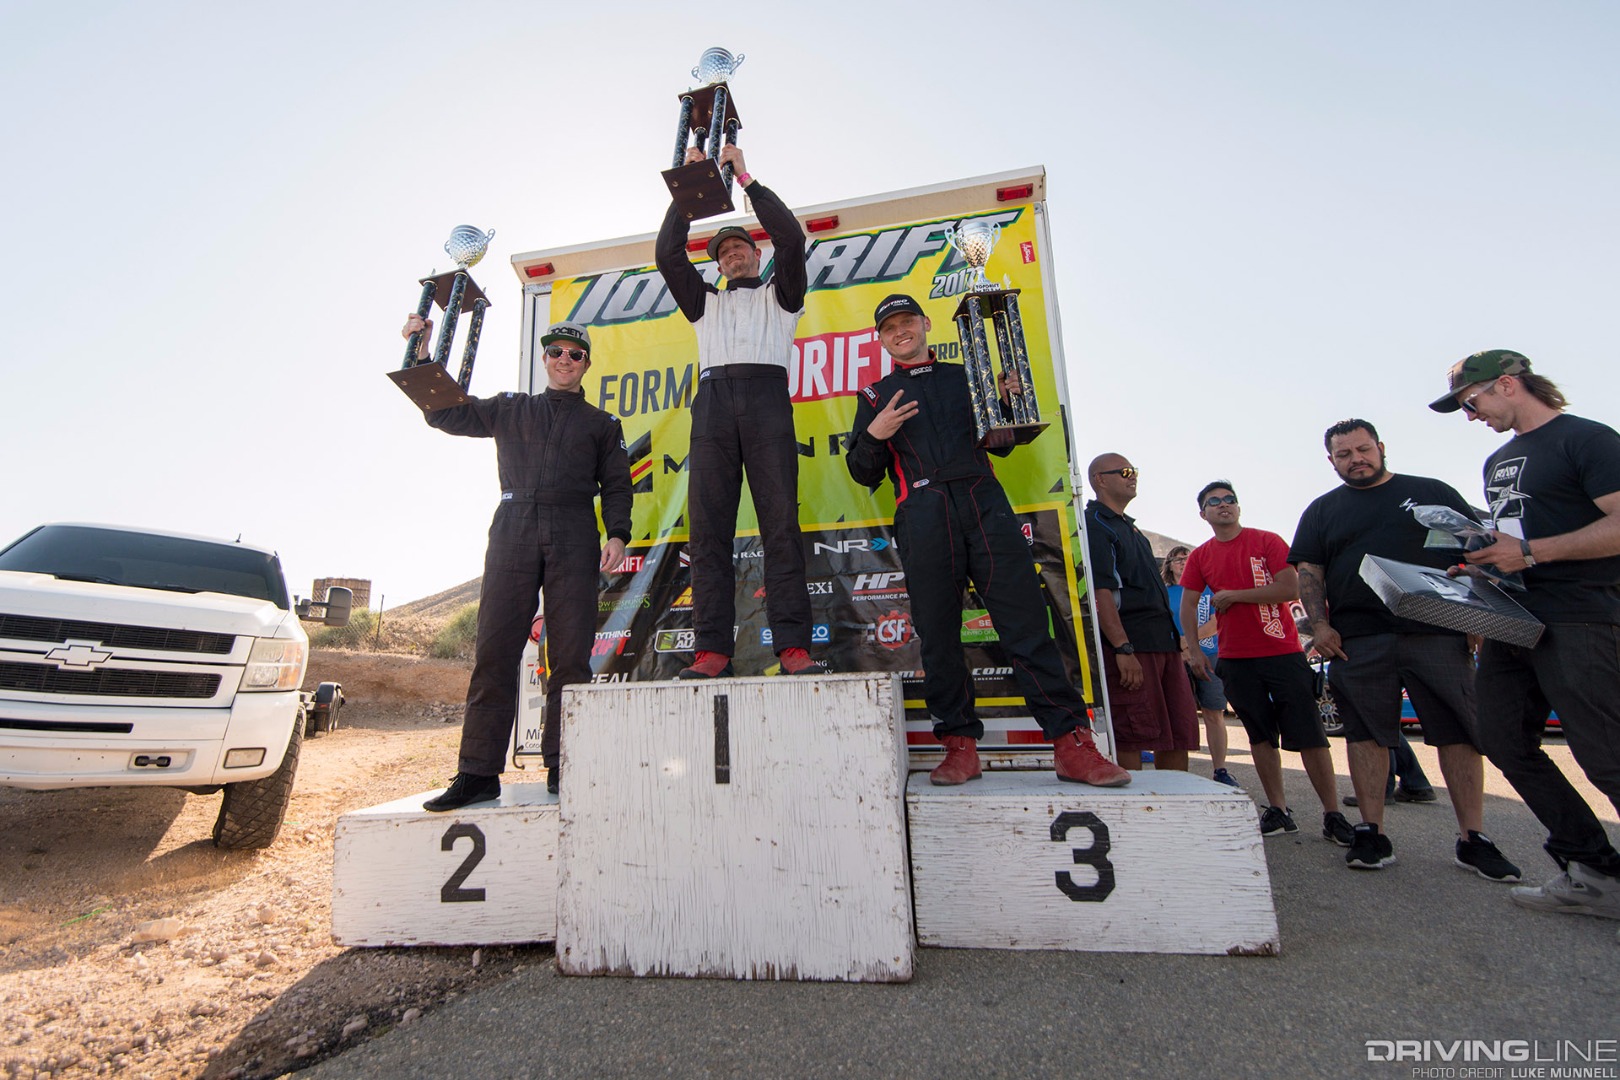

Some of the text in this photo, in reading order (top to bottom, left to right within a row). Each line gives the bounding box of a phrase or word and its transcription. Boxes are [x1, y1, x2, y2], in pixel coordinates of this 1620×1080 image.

[928, 268, 977, 299] 2017
[599, 362, 699, 417] FORM
[609, 556, 642, 573] RIFT
[676, 632, 695, 640] FO
[877, 620, 906, 643] CSF
[440, 823, 486, 902] 2
[1050, 811, 1116, 902] 3
